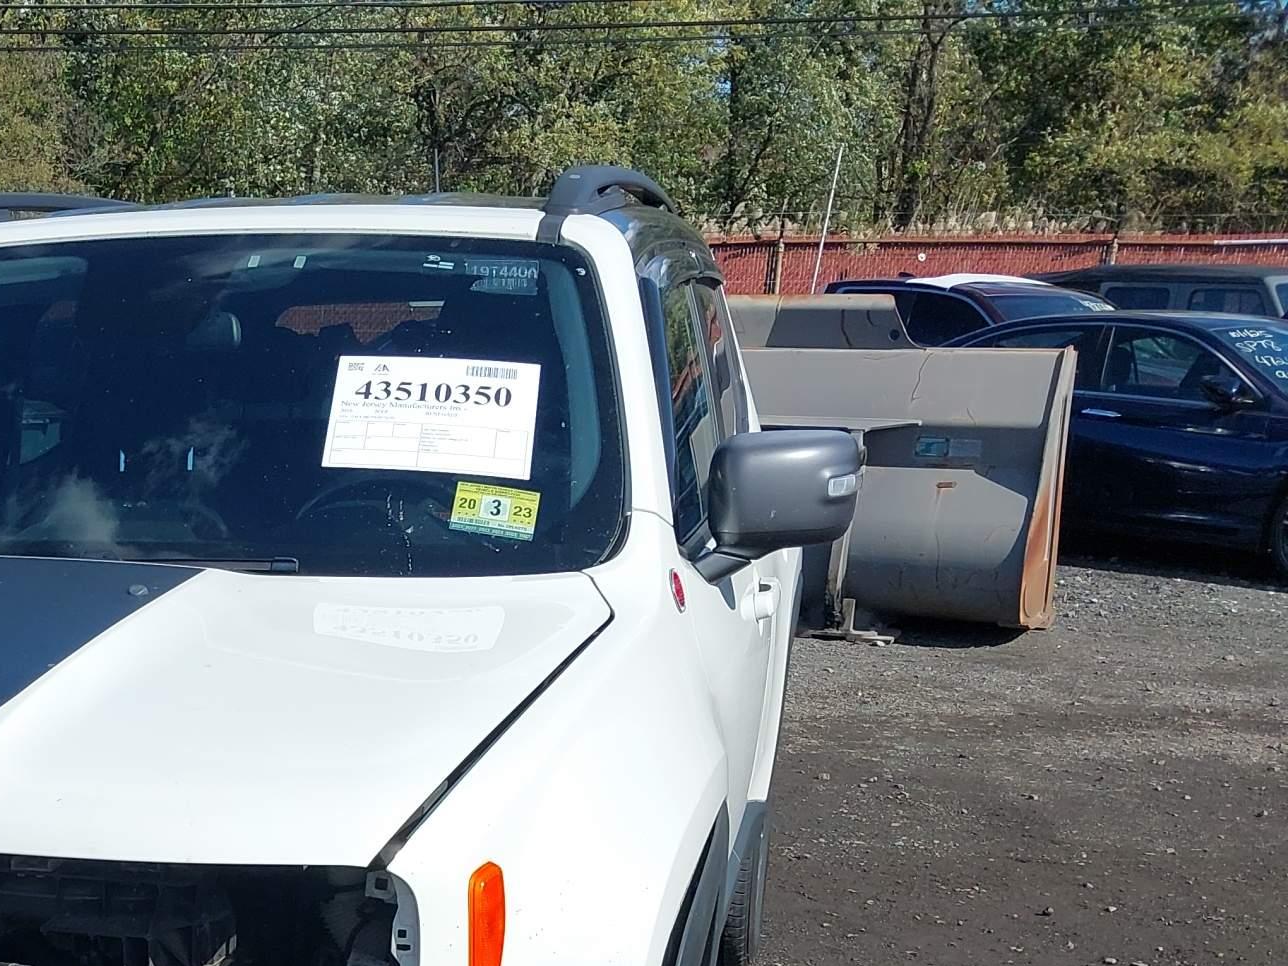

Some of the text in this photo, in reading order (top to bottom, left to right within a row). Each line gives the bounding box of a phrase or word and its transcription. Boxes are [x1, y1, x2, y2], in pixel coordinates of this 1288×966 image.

[354, 380, 513, 408] 43510350
[458, 497, 532, 518] 20 3 23
